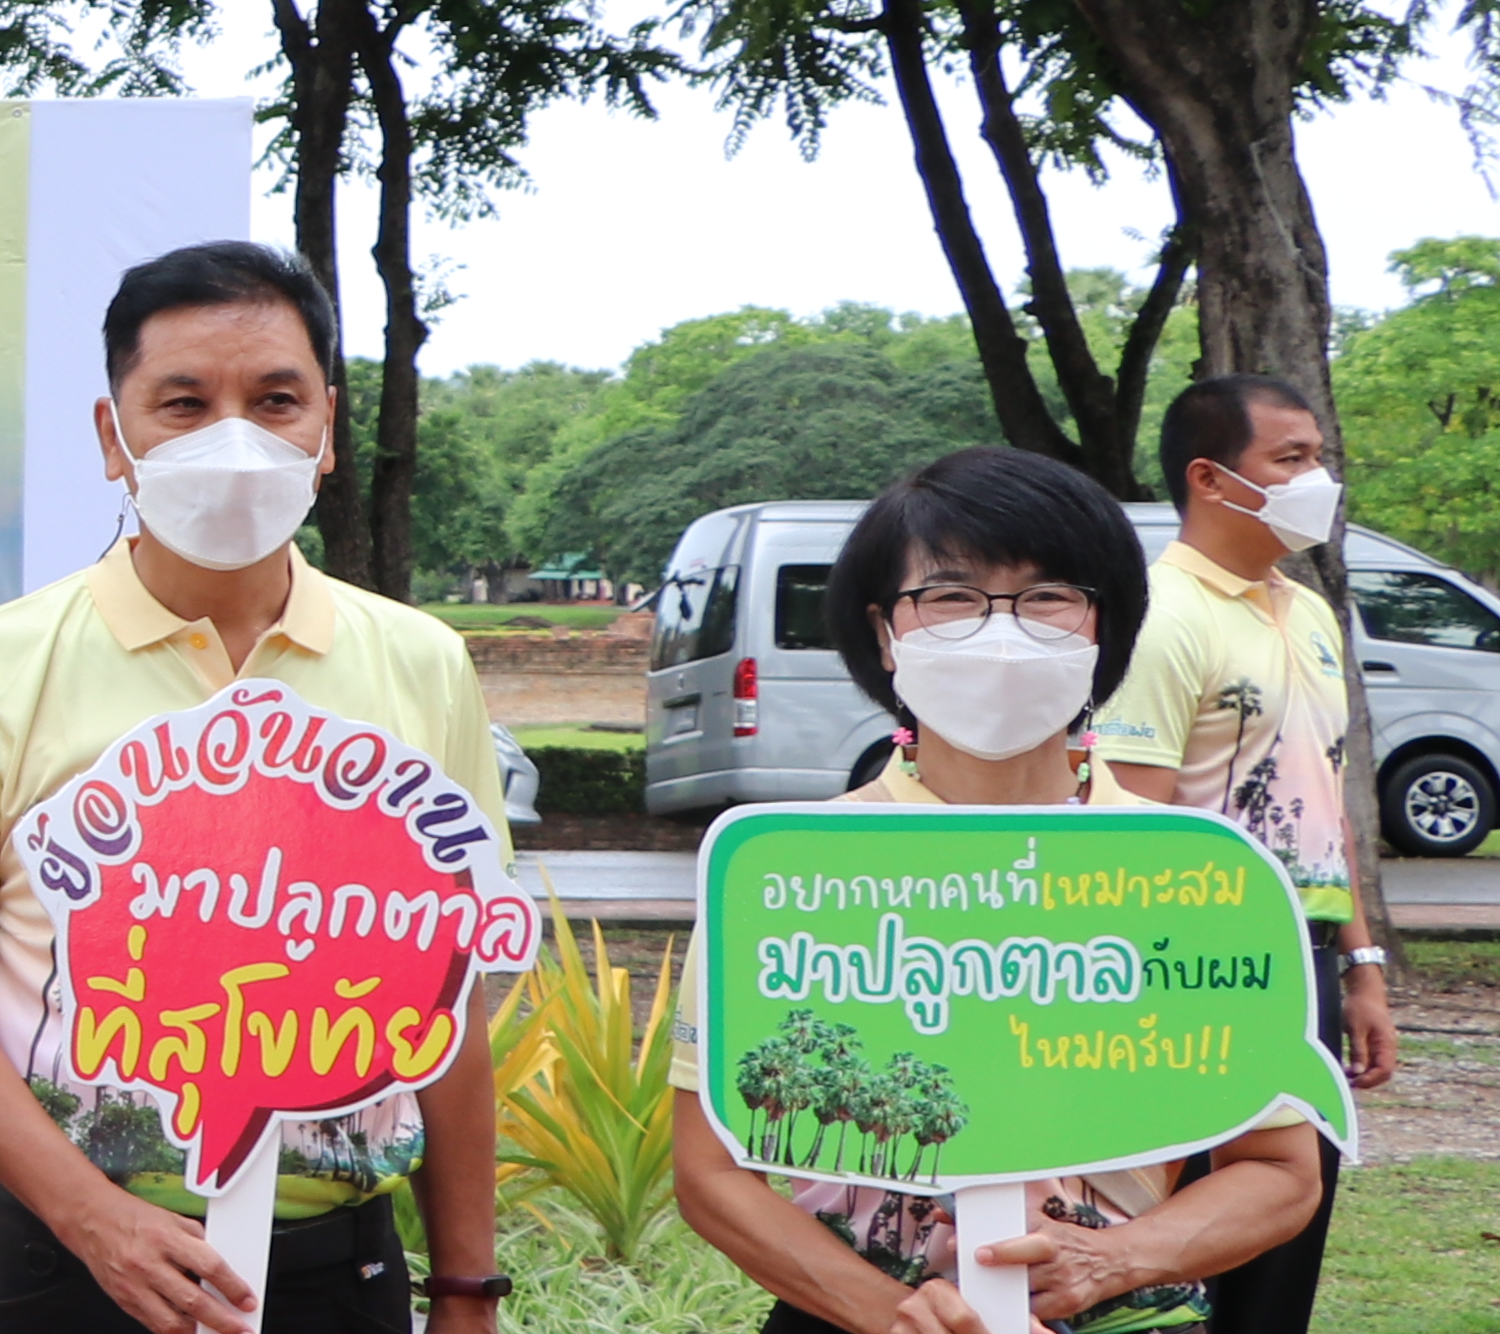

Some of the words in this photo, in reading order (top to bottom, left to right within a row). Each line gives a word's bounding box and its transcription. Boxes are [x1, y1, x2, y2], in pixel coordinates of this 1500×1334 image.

[129, 847, 528, 961] มาปลูกตาล
[76, 925, 453, 1136] ที่สุโขทัย
[1008, 1015, 1232, 1074] ไหมครับ!!
